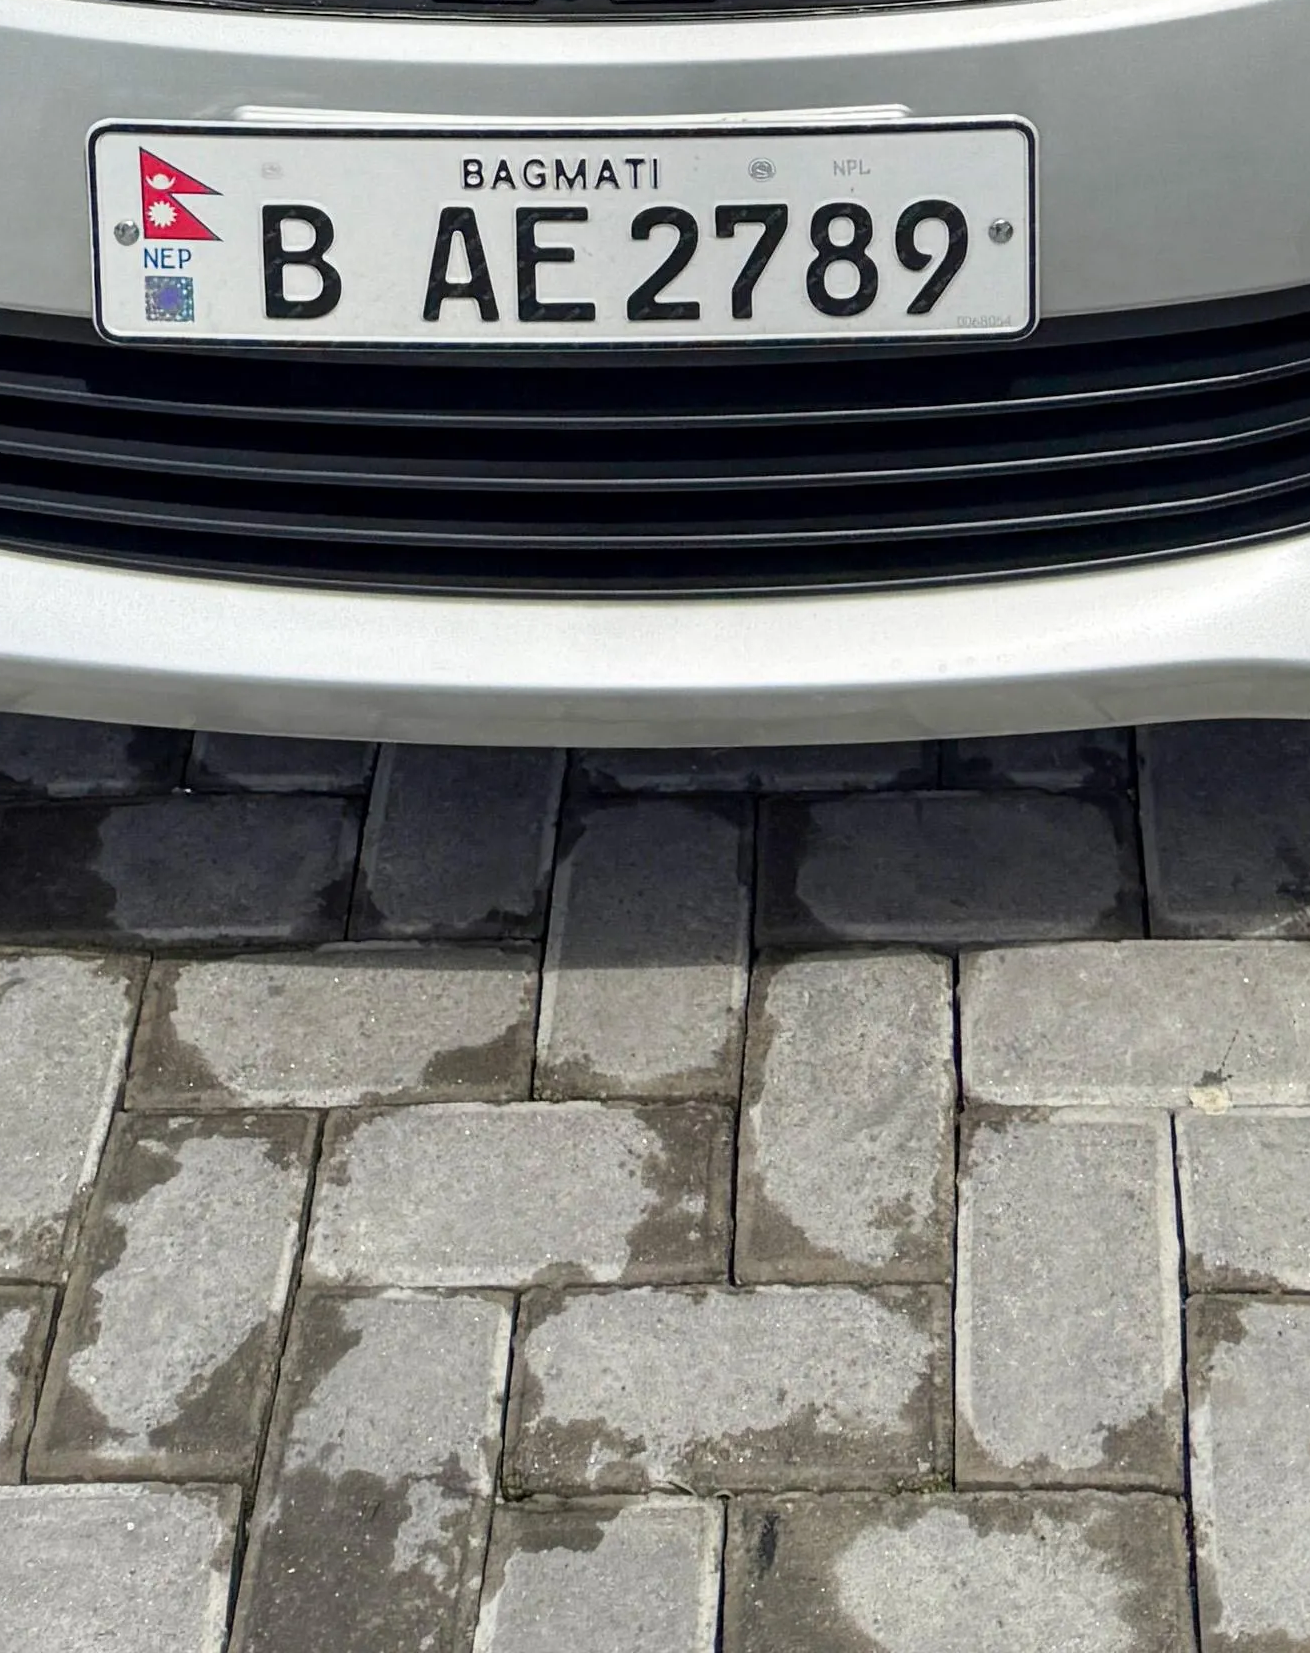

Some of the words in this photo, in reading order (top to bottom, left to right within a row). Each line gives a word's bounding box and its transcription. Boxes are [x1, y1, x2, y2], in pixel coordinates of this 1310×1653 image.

[462, 158, 659, 191] BAGMATI
[833, 160, 871, 176] NPL
[144, 248, 192, 269] NEP
[262, 204, 342, 320] B
